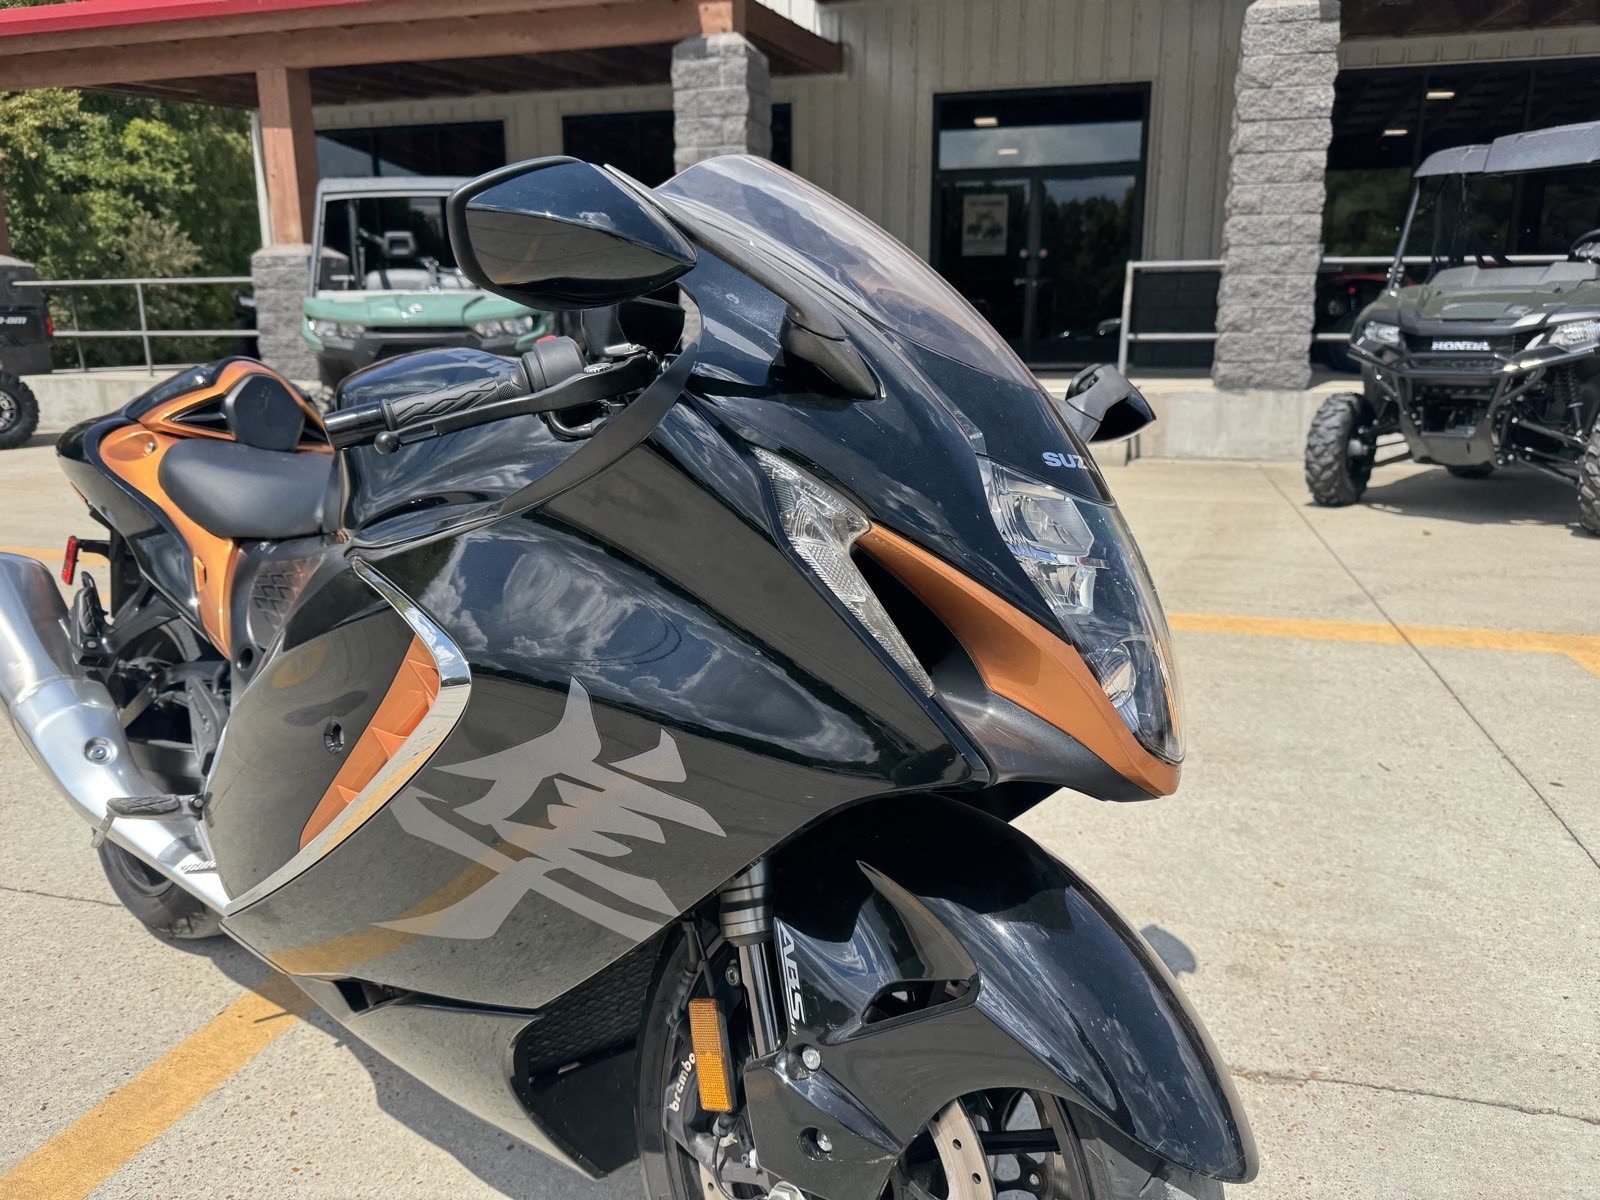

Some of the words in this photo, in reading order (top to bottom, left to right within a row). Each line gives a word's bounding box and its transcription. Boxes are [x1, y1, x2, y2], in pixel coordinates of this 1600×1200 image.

[1431, 341, 1491, 351] HONDA
[777, 920, 806, 1026] ABS
[666, 1052, 696, 1112] brembo
